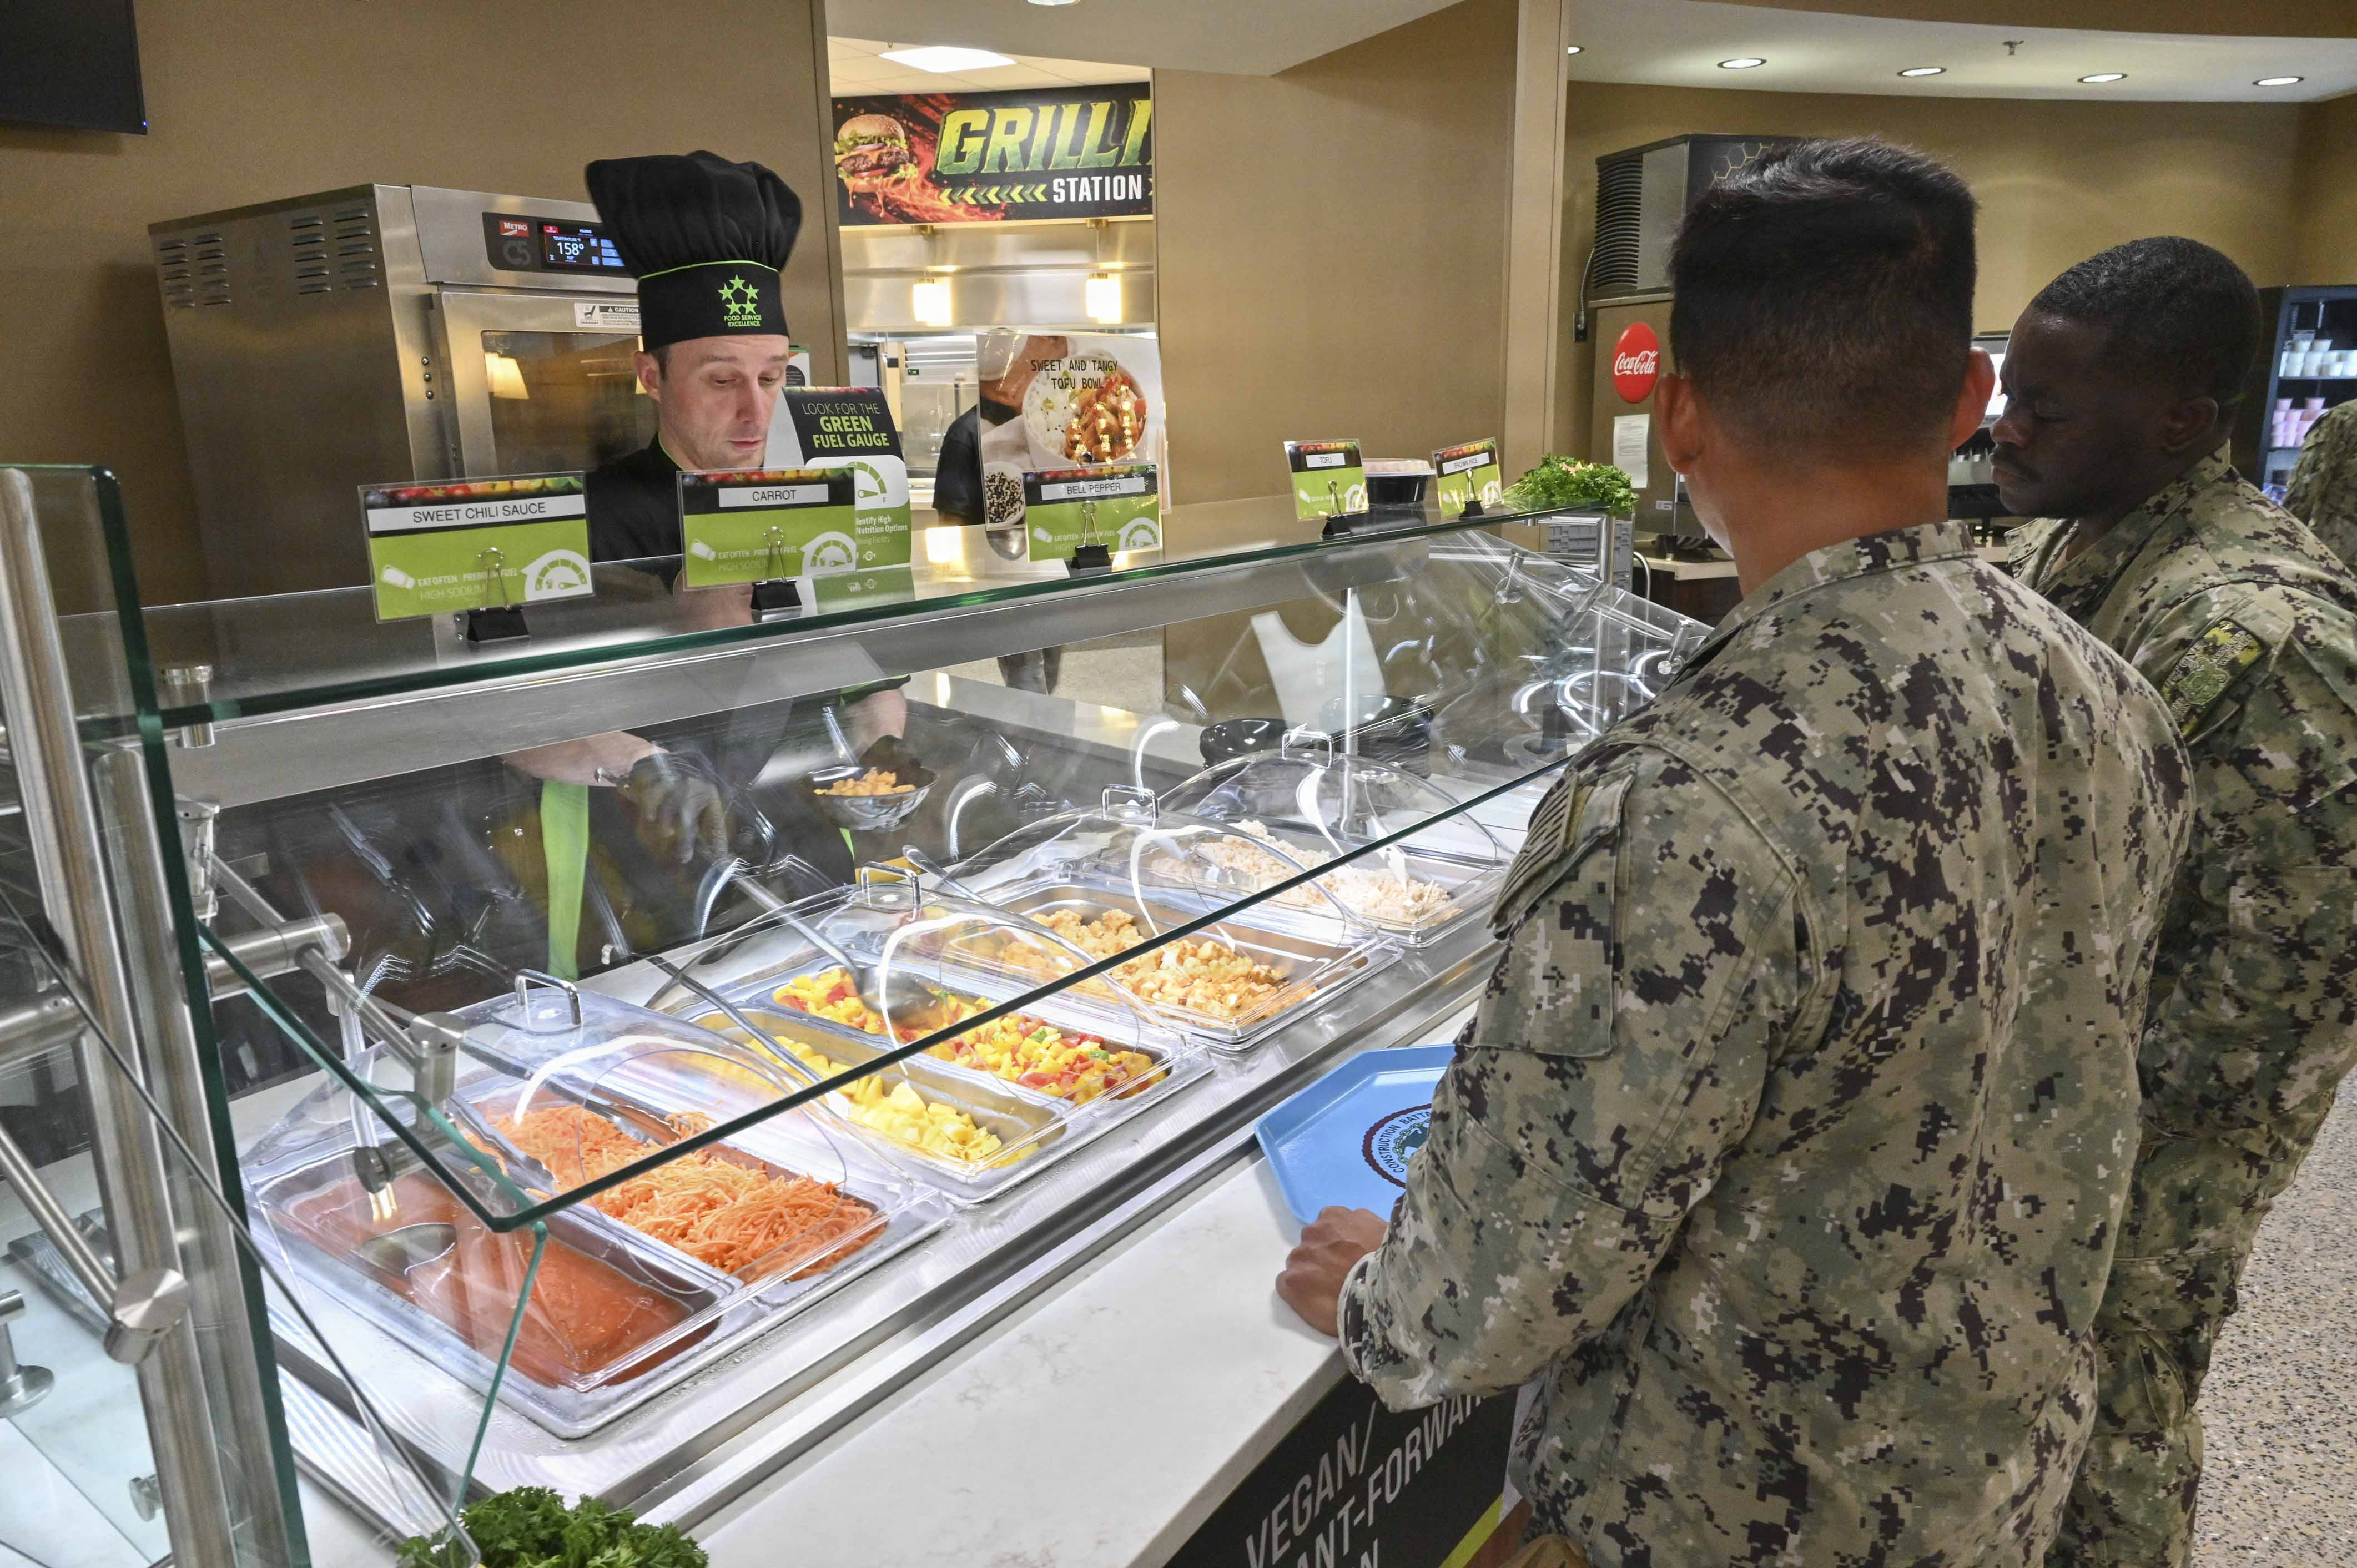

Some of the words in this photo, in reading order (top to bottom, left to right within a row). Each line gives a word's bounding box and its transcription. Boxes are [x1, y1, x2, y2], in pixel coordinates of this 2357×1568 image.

[938, 100, 1151, 174] GRILLI
[1053, 174, 1142, 203] STATION
[1031, 360, 1061, 371] SWEET
[1069, 360, 1086, 371] AND
[1091, 360, 1117, 371] TANGY
[1614, 350, 1658, 375] Coca-Cola
[1051, 378, 1075, 389] TOFU
[1082, 378, 1103, 389] BOWL
[802, 403, 834, 415] LOOK
[835, 403, 858, 415] FOR
[858, 403, 881, 414] THE
[820, 416, 873, 432] GREEN
[813, 434, 845, 448] FUEL
[847, 433, 889, 447] GAUGE
[752, 489, 797, 501] CARROT
[1067, 485, 1086, 495] BELL
[1089, 482, 1121, 493] PEPPER
[413, 508, 461, 523] SWEET
[465, 506, 498, 519] CHILI
[502, 502, 546, 516] SAUCE
[856, 516, 876, 526] entify
[878, 515, 892, 525] High
[857, 525, 884, 535] Nutrition
[885, 524, 908, 533] Options
[783, 546, 798, 554] FUEL
[417, 578, 431, 587] EAT
[432, 575, 458, 585] OFTEN
[501, 568, 517, 577] FUEL
[420, 589, 445, 601] HIGH
[1399, 1112, 1431, 1124] BATTA
[1377, 1125, 1404, 1173] CONSTRUCTION
[1246, 1400, 1377, 1568] VEGAN/
